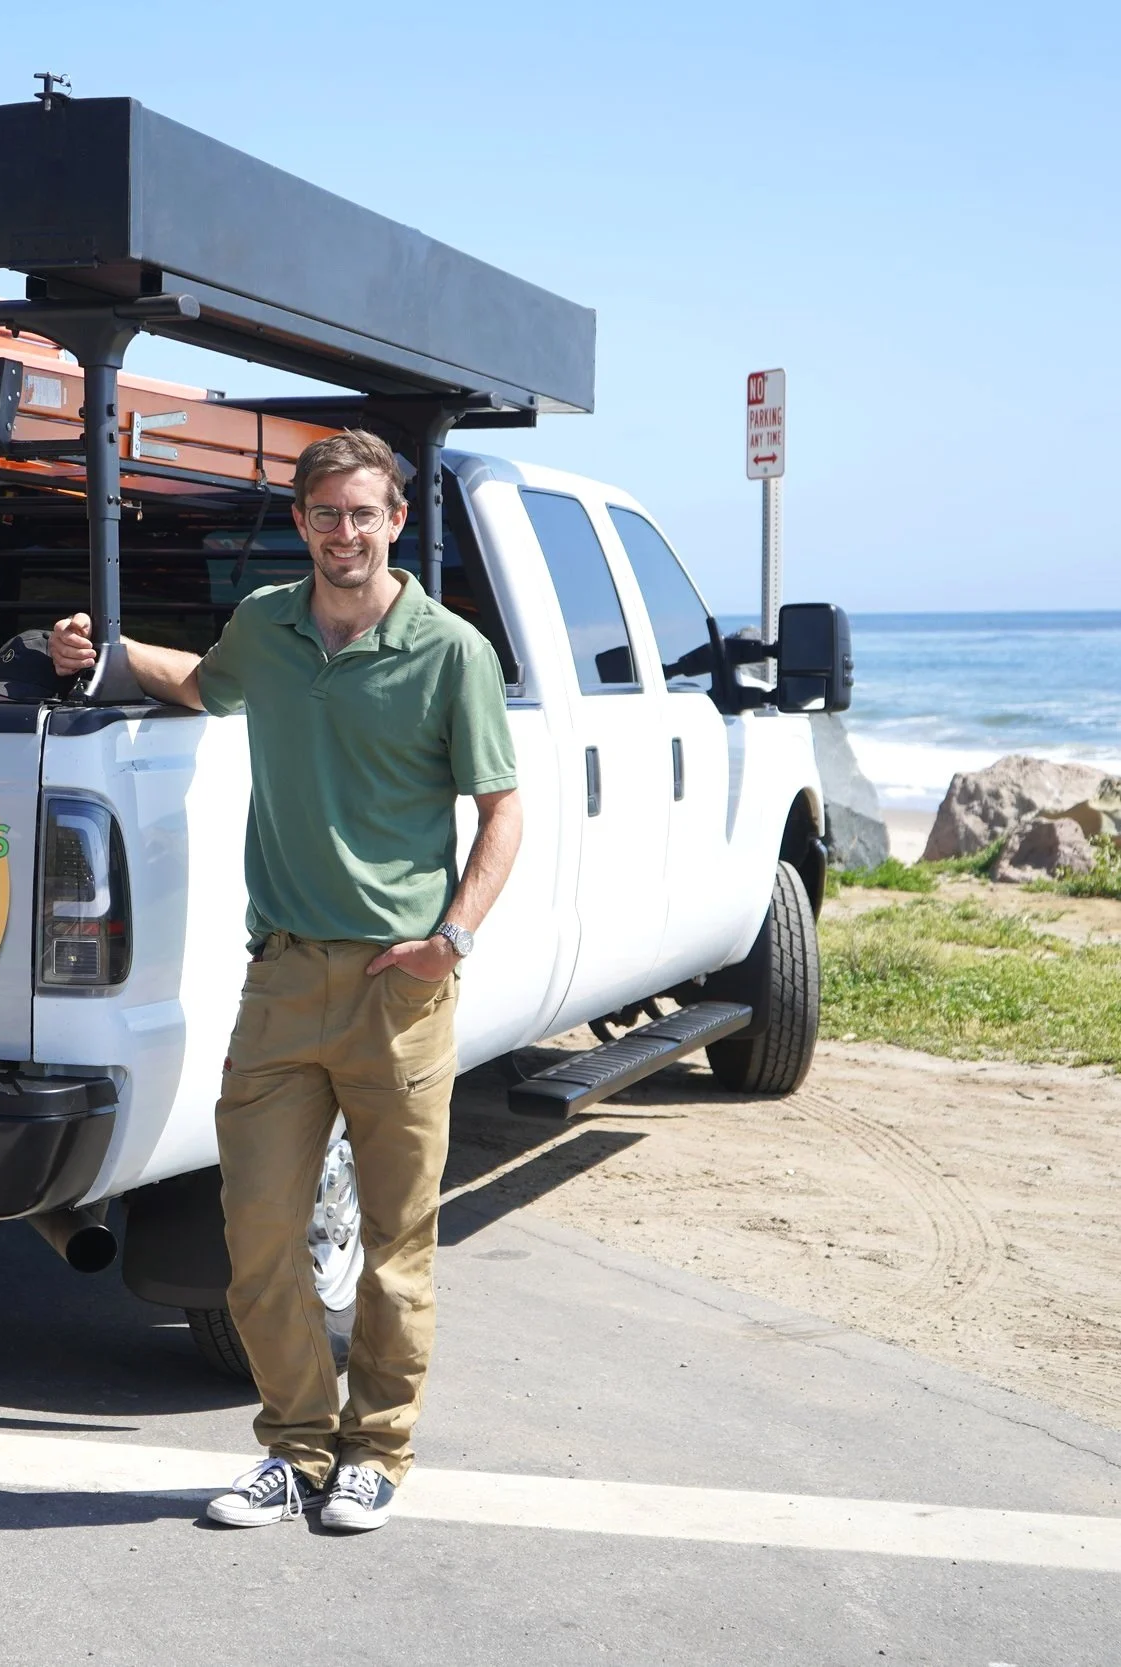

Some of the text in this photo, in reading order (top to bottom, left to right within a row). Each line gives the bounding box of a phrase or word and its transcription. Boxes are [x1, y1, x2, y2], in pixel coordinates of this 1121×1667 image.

[749, 376, 764, 401] NO
[749, 406, 782, 429] PARKING
[750, 430, 782, 448] ANY TIME
